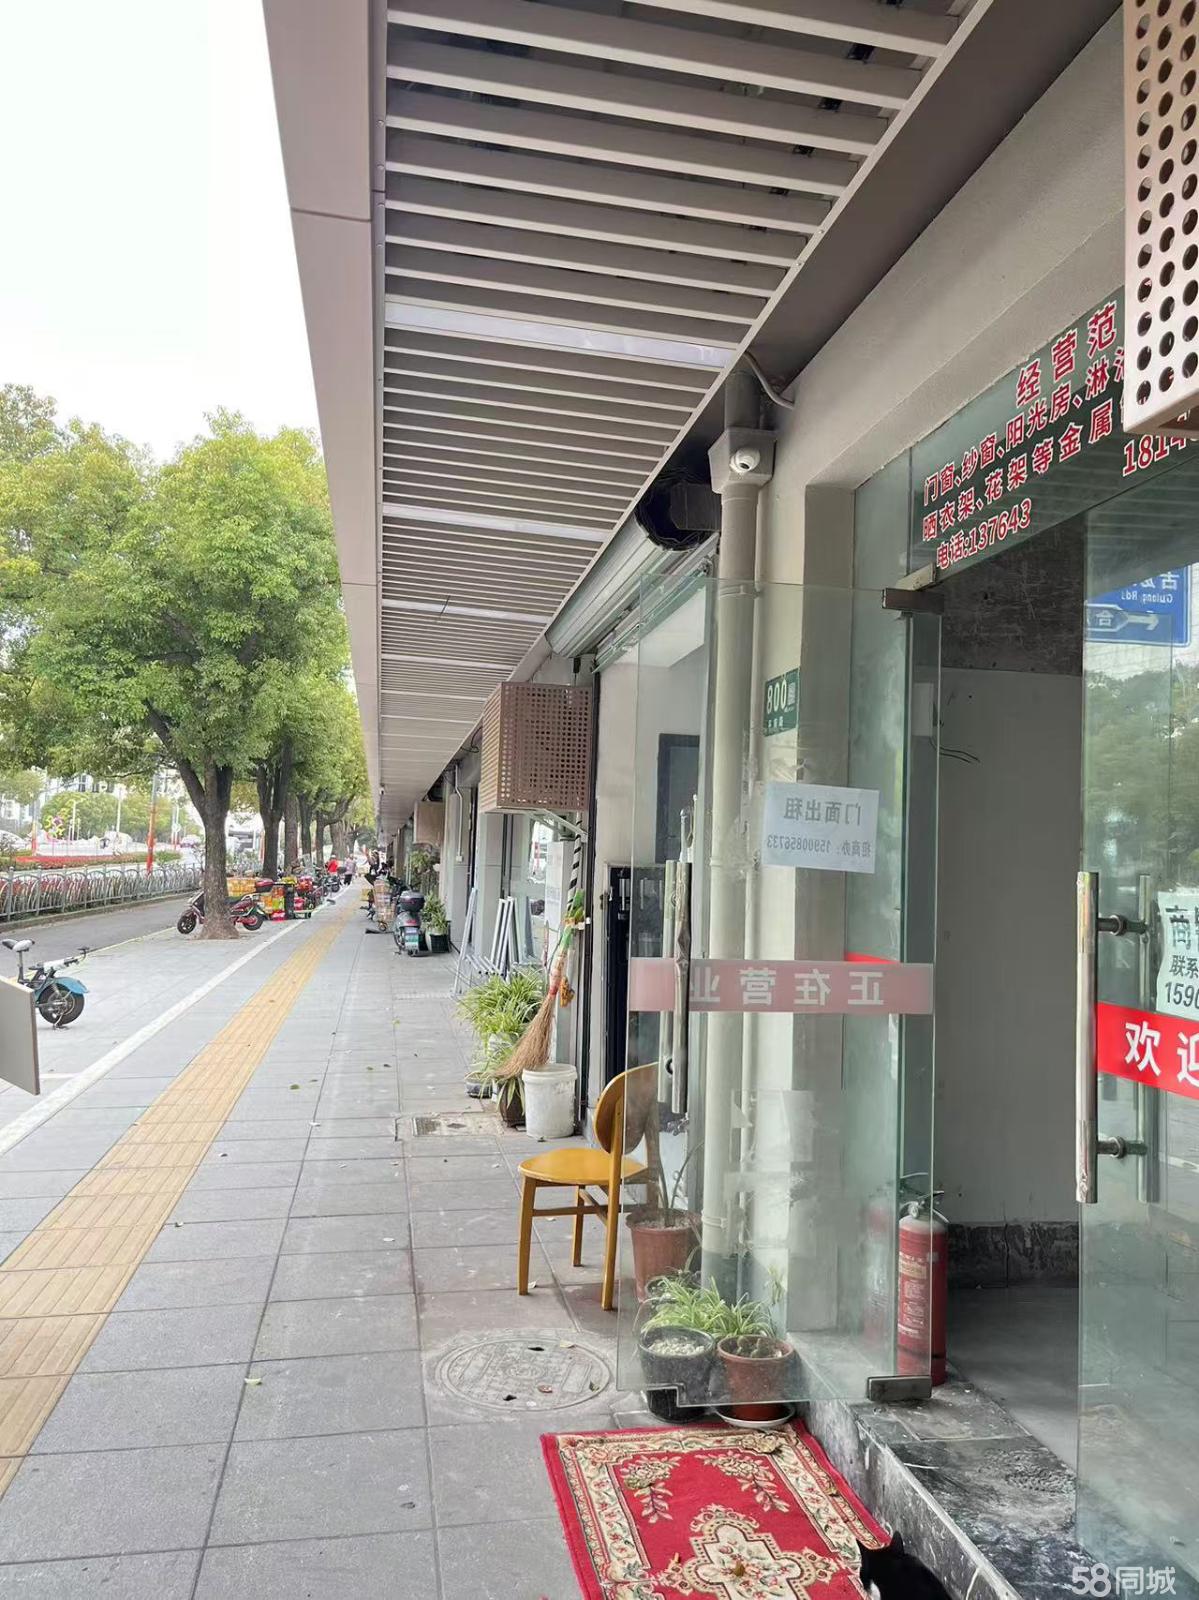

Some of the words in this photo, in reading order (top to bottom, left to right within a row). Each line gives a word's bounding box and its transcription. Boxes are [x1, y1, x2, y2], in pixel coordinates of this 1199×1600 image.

[1016, 300, 1117, 408] 经营范
[923, 396, 1124, 542] 晒衣架、花架等金属
